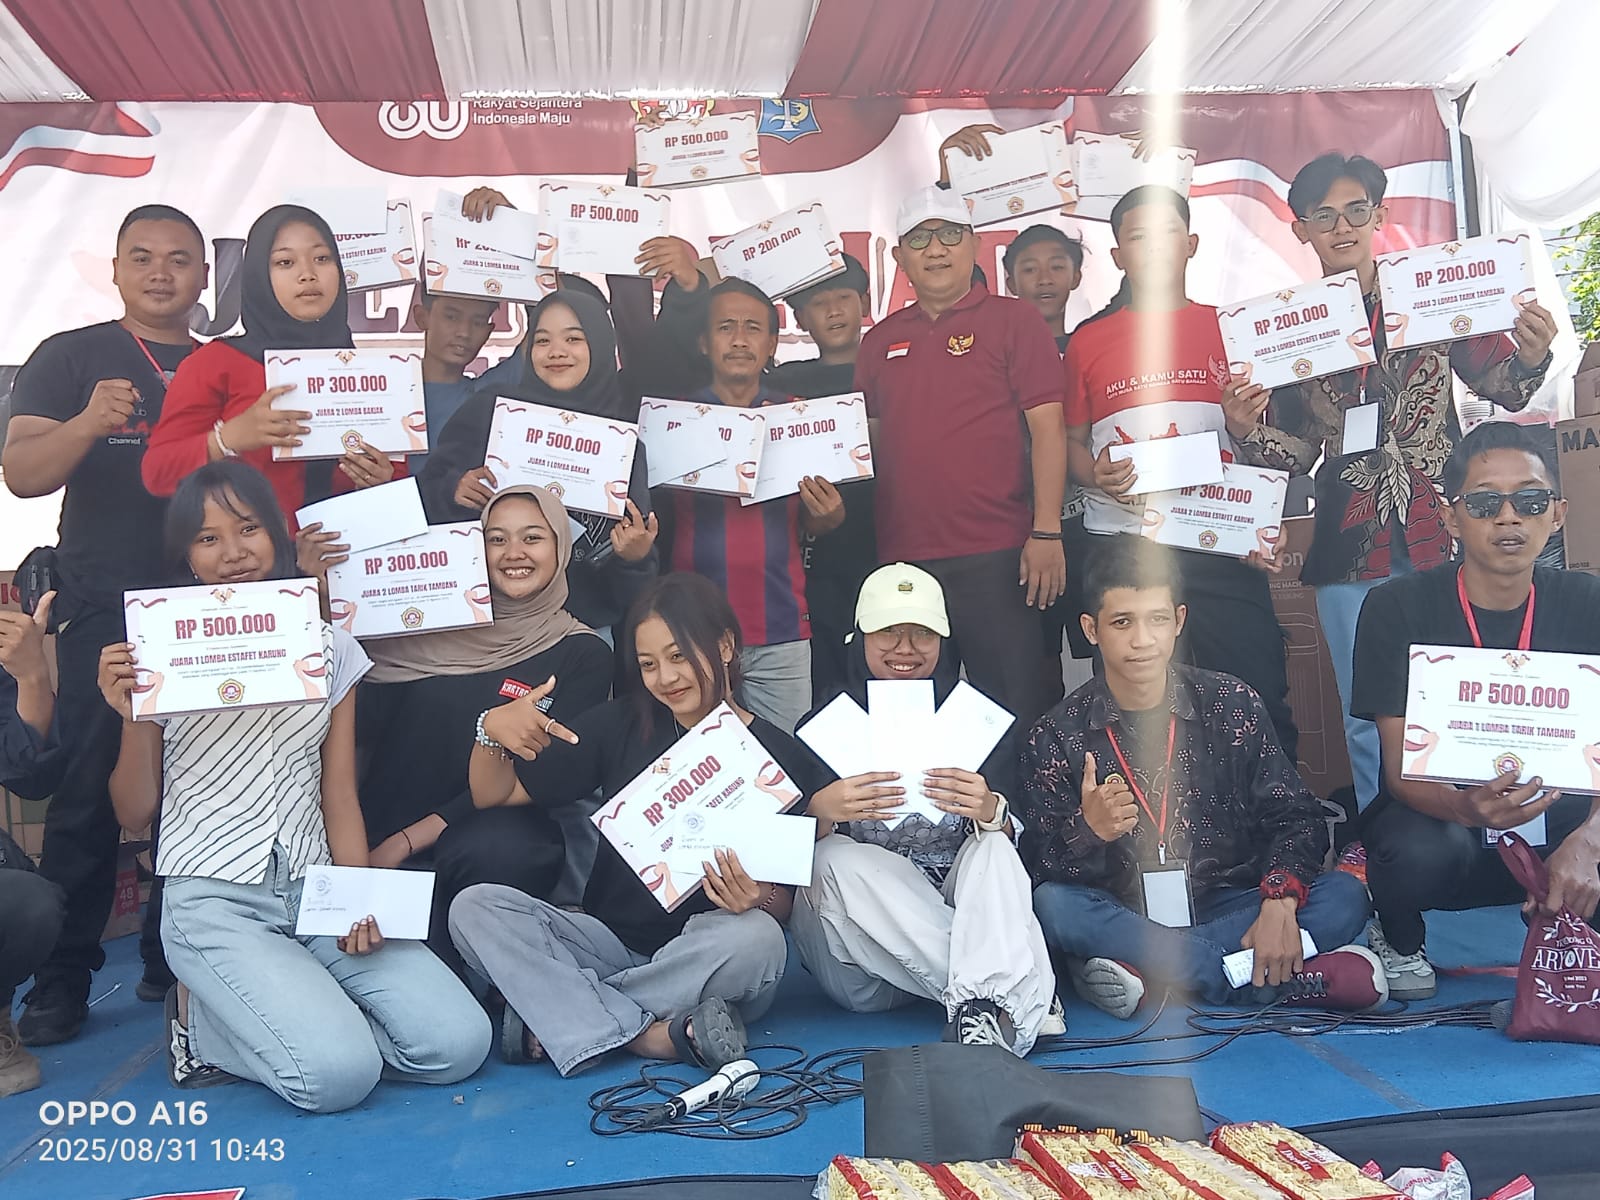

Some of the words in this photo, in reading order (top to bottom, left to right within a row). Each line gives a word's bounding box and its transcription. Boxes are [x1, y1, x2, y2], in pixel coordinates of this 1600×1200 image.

[473, 112, 537, 125] Indonesia
[540, 113, 571, 126] Maju
[664, 136, 678, 148] RP
[681, 130, 729, 146] 500.000
[570, 203, 587, 219] RP
[589, 205, 639, 223] 500.000
[742, 243, 757, 262] RP
[1415, 271, 1433, 288] RP
[1437, 259, 1496, 284] 200.000
[1254, 318, 1271, 336] RP
[1274, 303, 1329, 331] 200.000
[307, 376, 325, 394] RP
[329, 375, 387, 393] 300.000
[1106, 380, 1125, 395] AKU
[1129, 377, 1138, 386] &
[1141, 371, 1175, 383] KAMU
[1178, 370, 1207, 379] SATU
[526, 427, 543, 444] RP
[546, 431, 601, 456] 500.000
[770, 427, 784, 442] RP
[788, 418, 836, 438] 300.000
[1562, 428, 1600, 453] MA
[1200, 484, 1252, 504] 300.000
[364, 558, 383, 575] RP
[387, 550, 449, 573] 300.000
[361, 589, 381, 599] JUARA
[382, 588, 387, 596] 2
[387, 586, 410, 596] LOMBA
[175, 619, 198, 640] RP
[203, 613, 276, 637] 500.000
[169, 657, 194, 667] JUARA
[195, 656, 200, 665] 1
[200, 654, 227, 665] LOMBA
[227, 651, 257, 663] ESTAFET
[258, 648, 287, 660] KARUNG
[1458, 680, 1483, 702] RP
[1488, 683, 1570, 709] 500.000
[1536, 727, 1576, 739] TAMBANG
[643, 801, 665, 827] RP
[662, 755, 722, 810] 300.000
